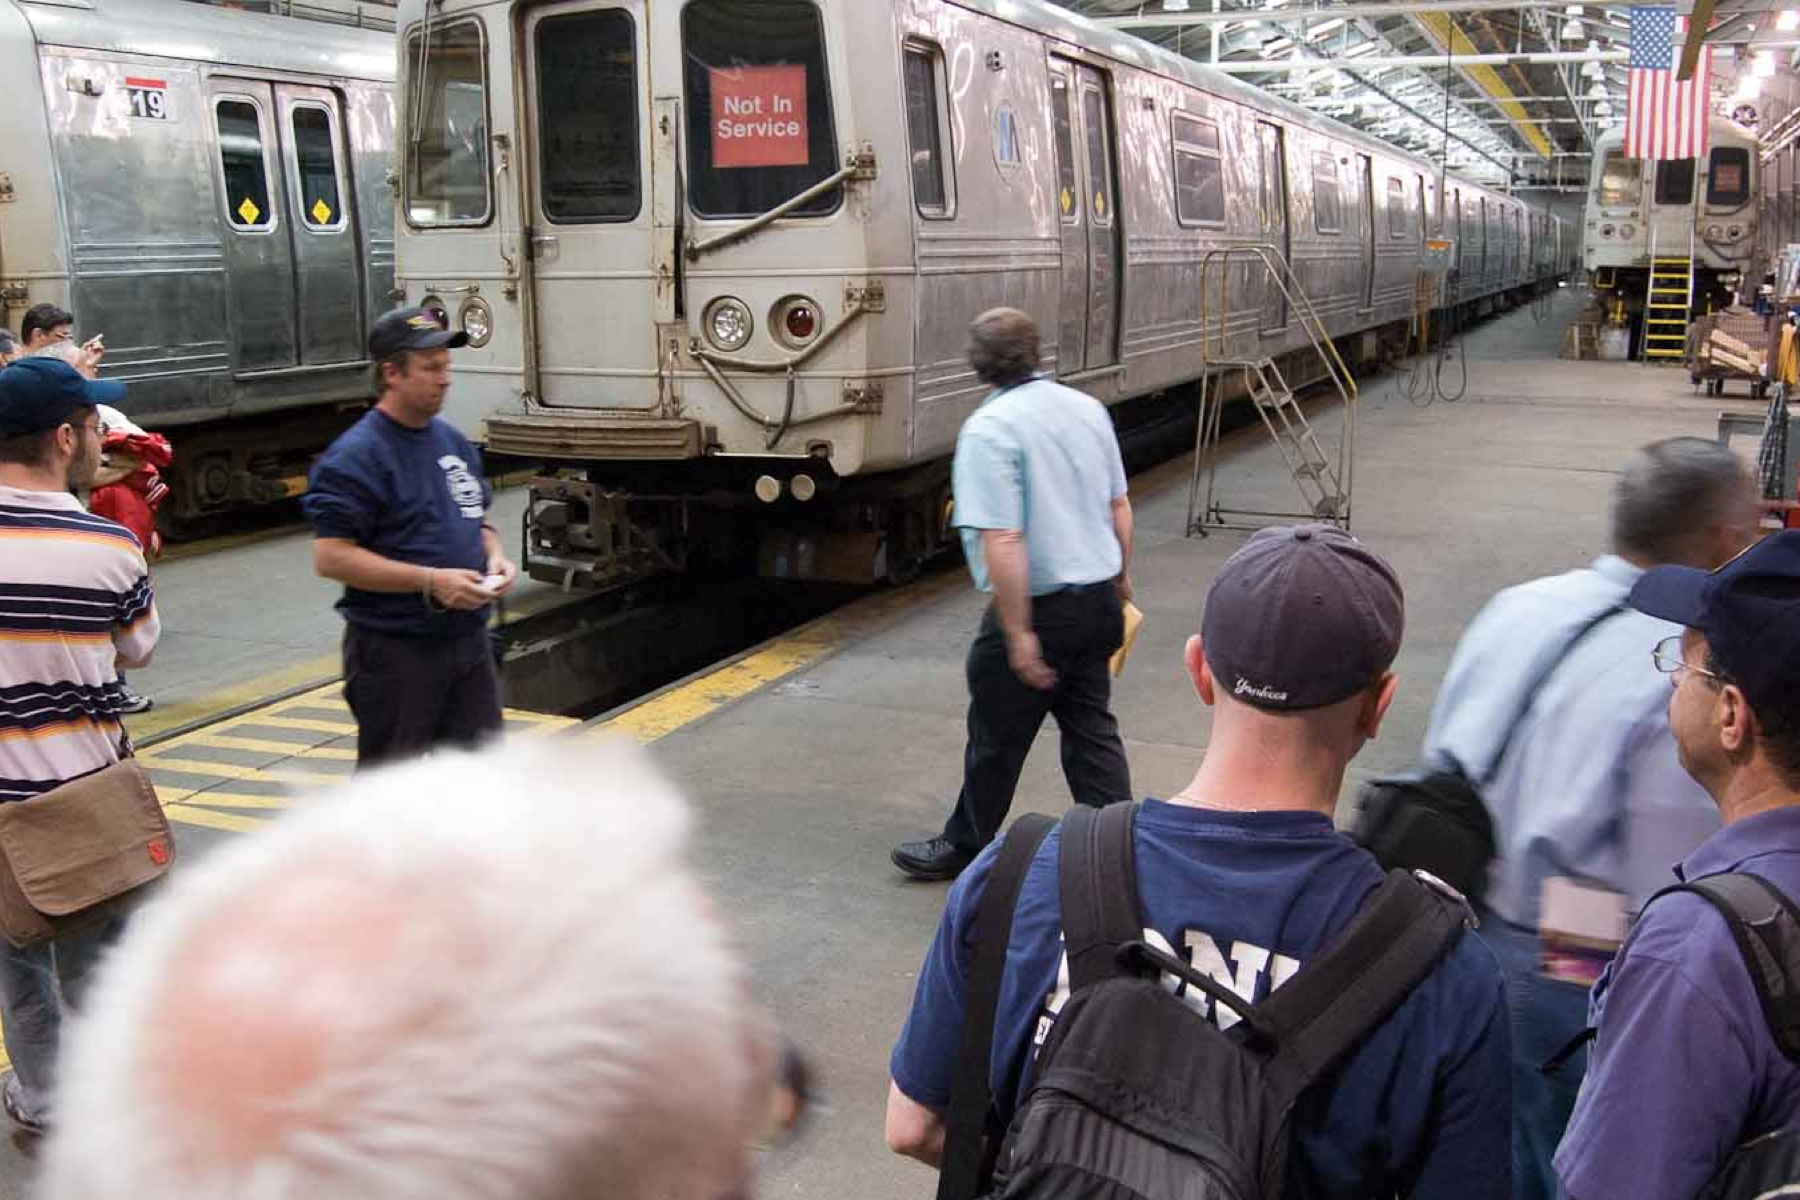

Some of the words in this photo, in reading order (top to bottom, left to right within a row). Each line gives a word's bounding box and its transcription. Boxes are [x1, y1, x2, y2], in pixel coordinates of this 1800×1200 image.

[724, 95, 763, 115] Not
[773, 95, 792, 113] In
[718, 118, 800, 139] Service
